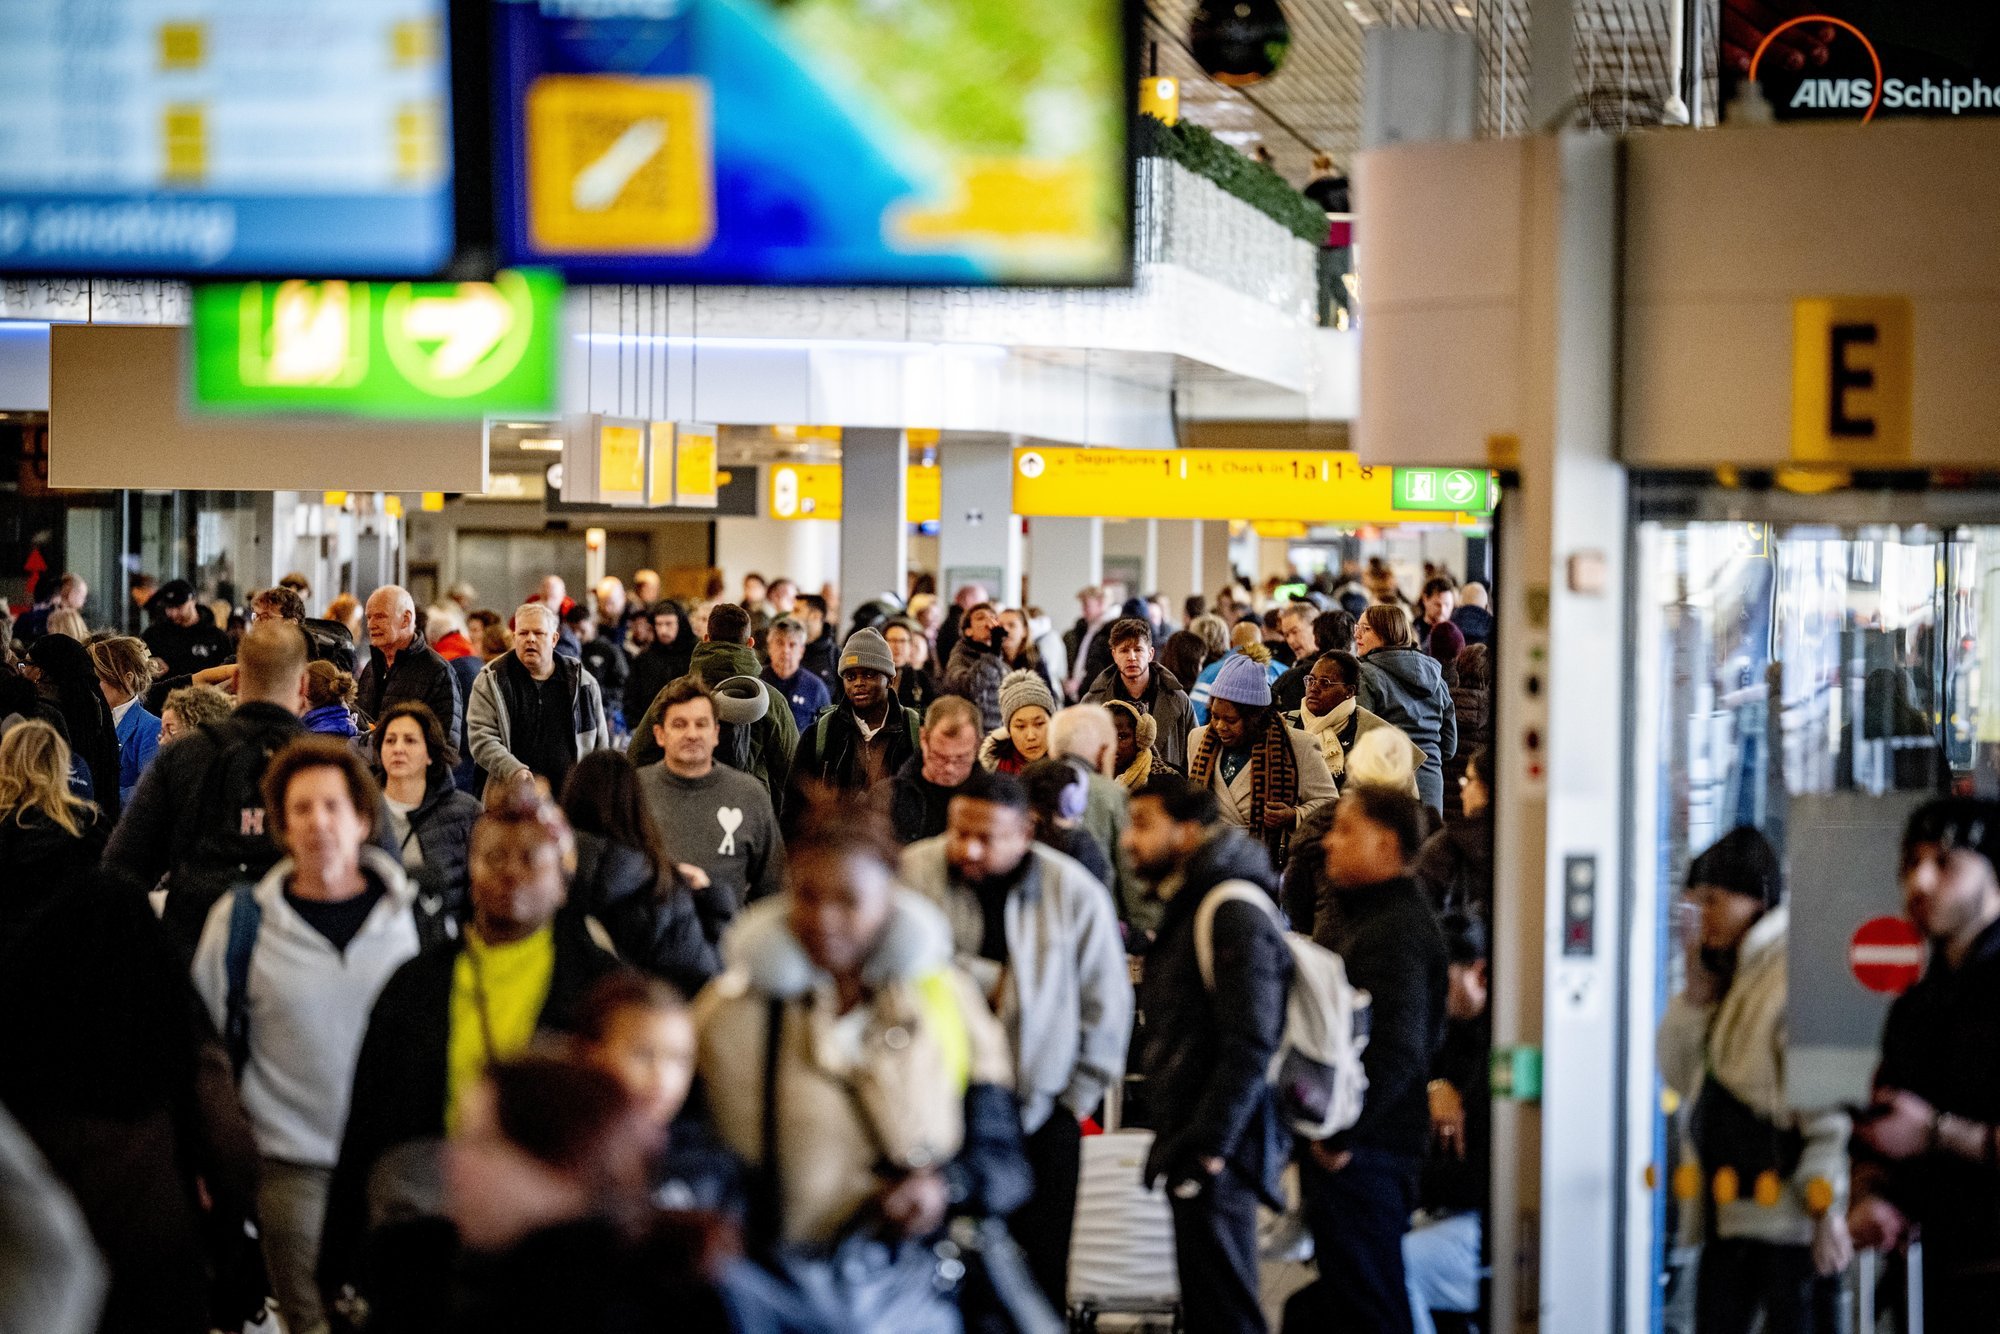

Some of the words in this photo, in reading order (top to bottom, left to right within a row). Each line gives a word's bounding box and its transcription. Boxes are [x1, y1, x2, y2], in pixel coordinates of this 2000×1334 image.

[1789, 78, 1873, 108] AMS
[1829, 322, 1877, 438] E
[1164, 458, 1170, 476] 1
[241, 808, 264, 835] H
